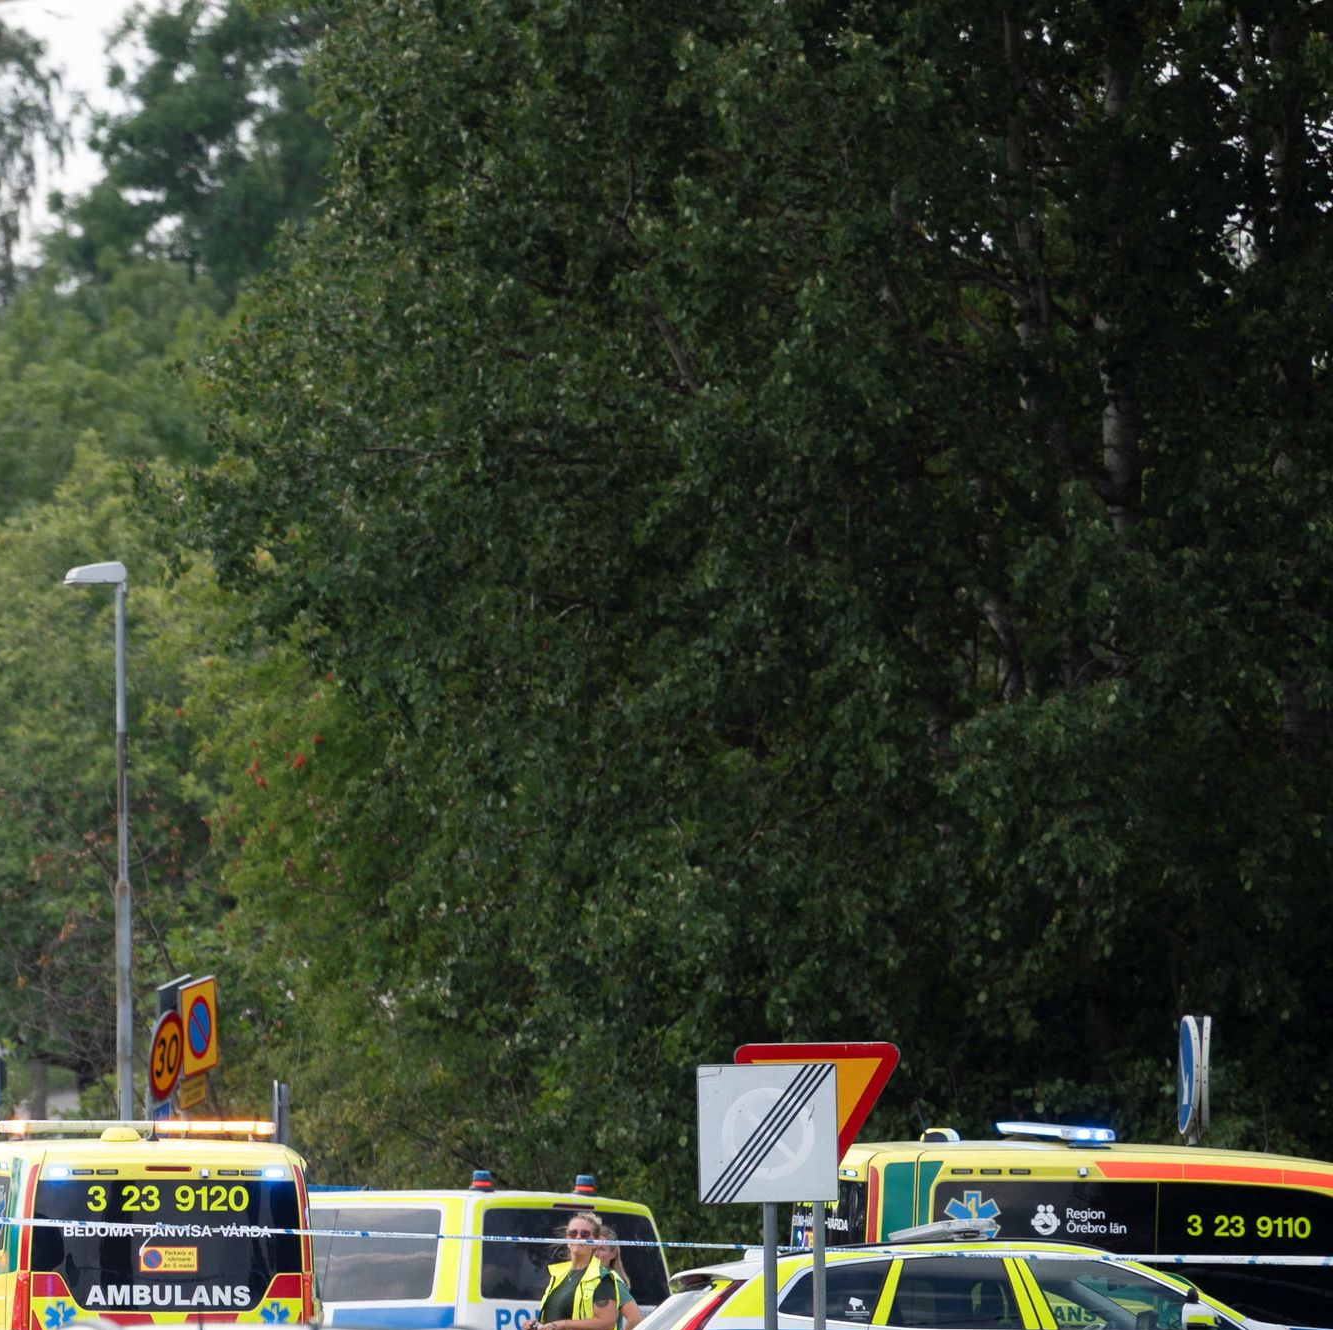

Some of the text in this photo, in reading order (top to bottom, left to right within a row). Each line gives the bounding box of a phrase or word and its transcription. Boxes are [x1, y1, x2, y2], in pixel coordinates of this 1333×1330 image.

[155, 1033, 178, 1078] 30
[87, 1185, 249, 1212] 3 23 9120
[1066, 1208, 1105, 1221] Region
[1066, 1220, 1127, 1234] Örebro län
[1186, 1214, 1312, 1239] 3 23 9110
[86, 1285, 251, 1307] AMBULANS
